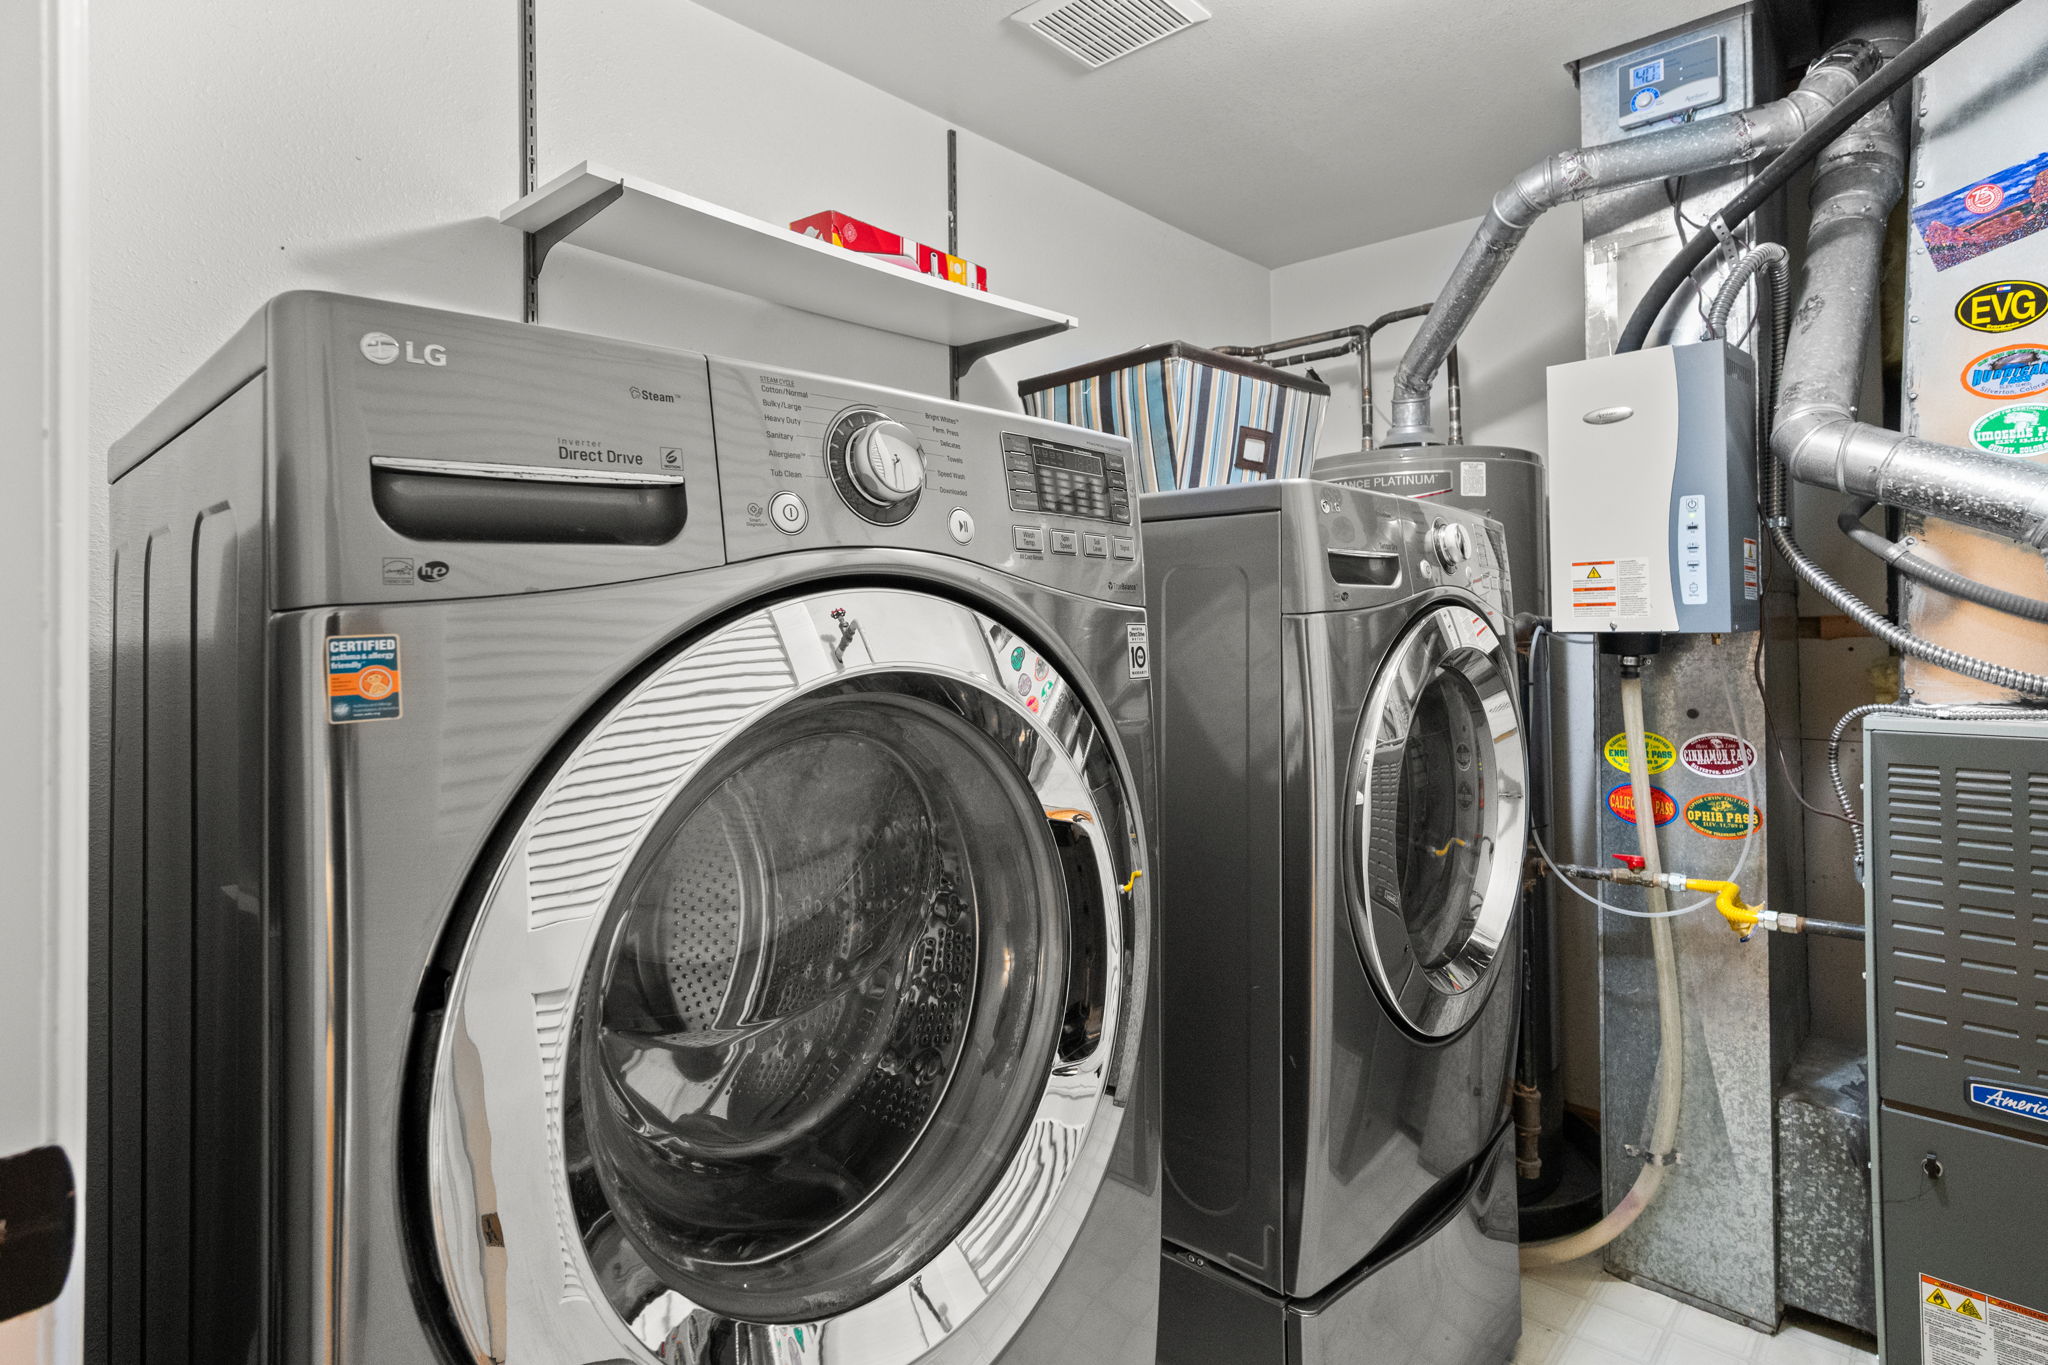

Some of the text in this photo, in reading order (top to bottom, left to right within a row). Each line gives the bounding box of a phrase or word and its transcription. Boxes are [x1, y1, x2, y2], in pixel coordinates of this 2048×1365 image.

[1972, 290, 2036, 324] EVG
[405, 340, 447, 367] LG
[2000, 374, 2033, 385] PASS
[641, 390, 675, 403] Steam
[761, 384, 809, 399] Cotton/Normal
[762, 399, 802, 412] Bulky/Large
[764, 413, 801, 426] Heavy Duty
[557, 437, 602, 448] Inverter
[766, 430, 794, 442] Sanitary
[558, 445, 643, 465] Direct Drive
[770, 468, 802, 479] Tub Clean
[1373, 475, 1436, 488] PLATINUM
[330, 639, 396, 653] CERTIFIED
[1130, 645, 1146, 669] 10
[1651, 750, 1673, 759] PASS
[1684, 748, 1753, 762] CINNAMON PAS
[1655, 800, 1674, 816] PASS
[1687, 810, 1759, 825] OPHIR PASS
[1984, 1089, 2048, 1117] Americ
